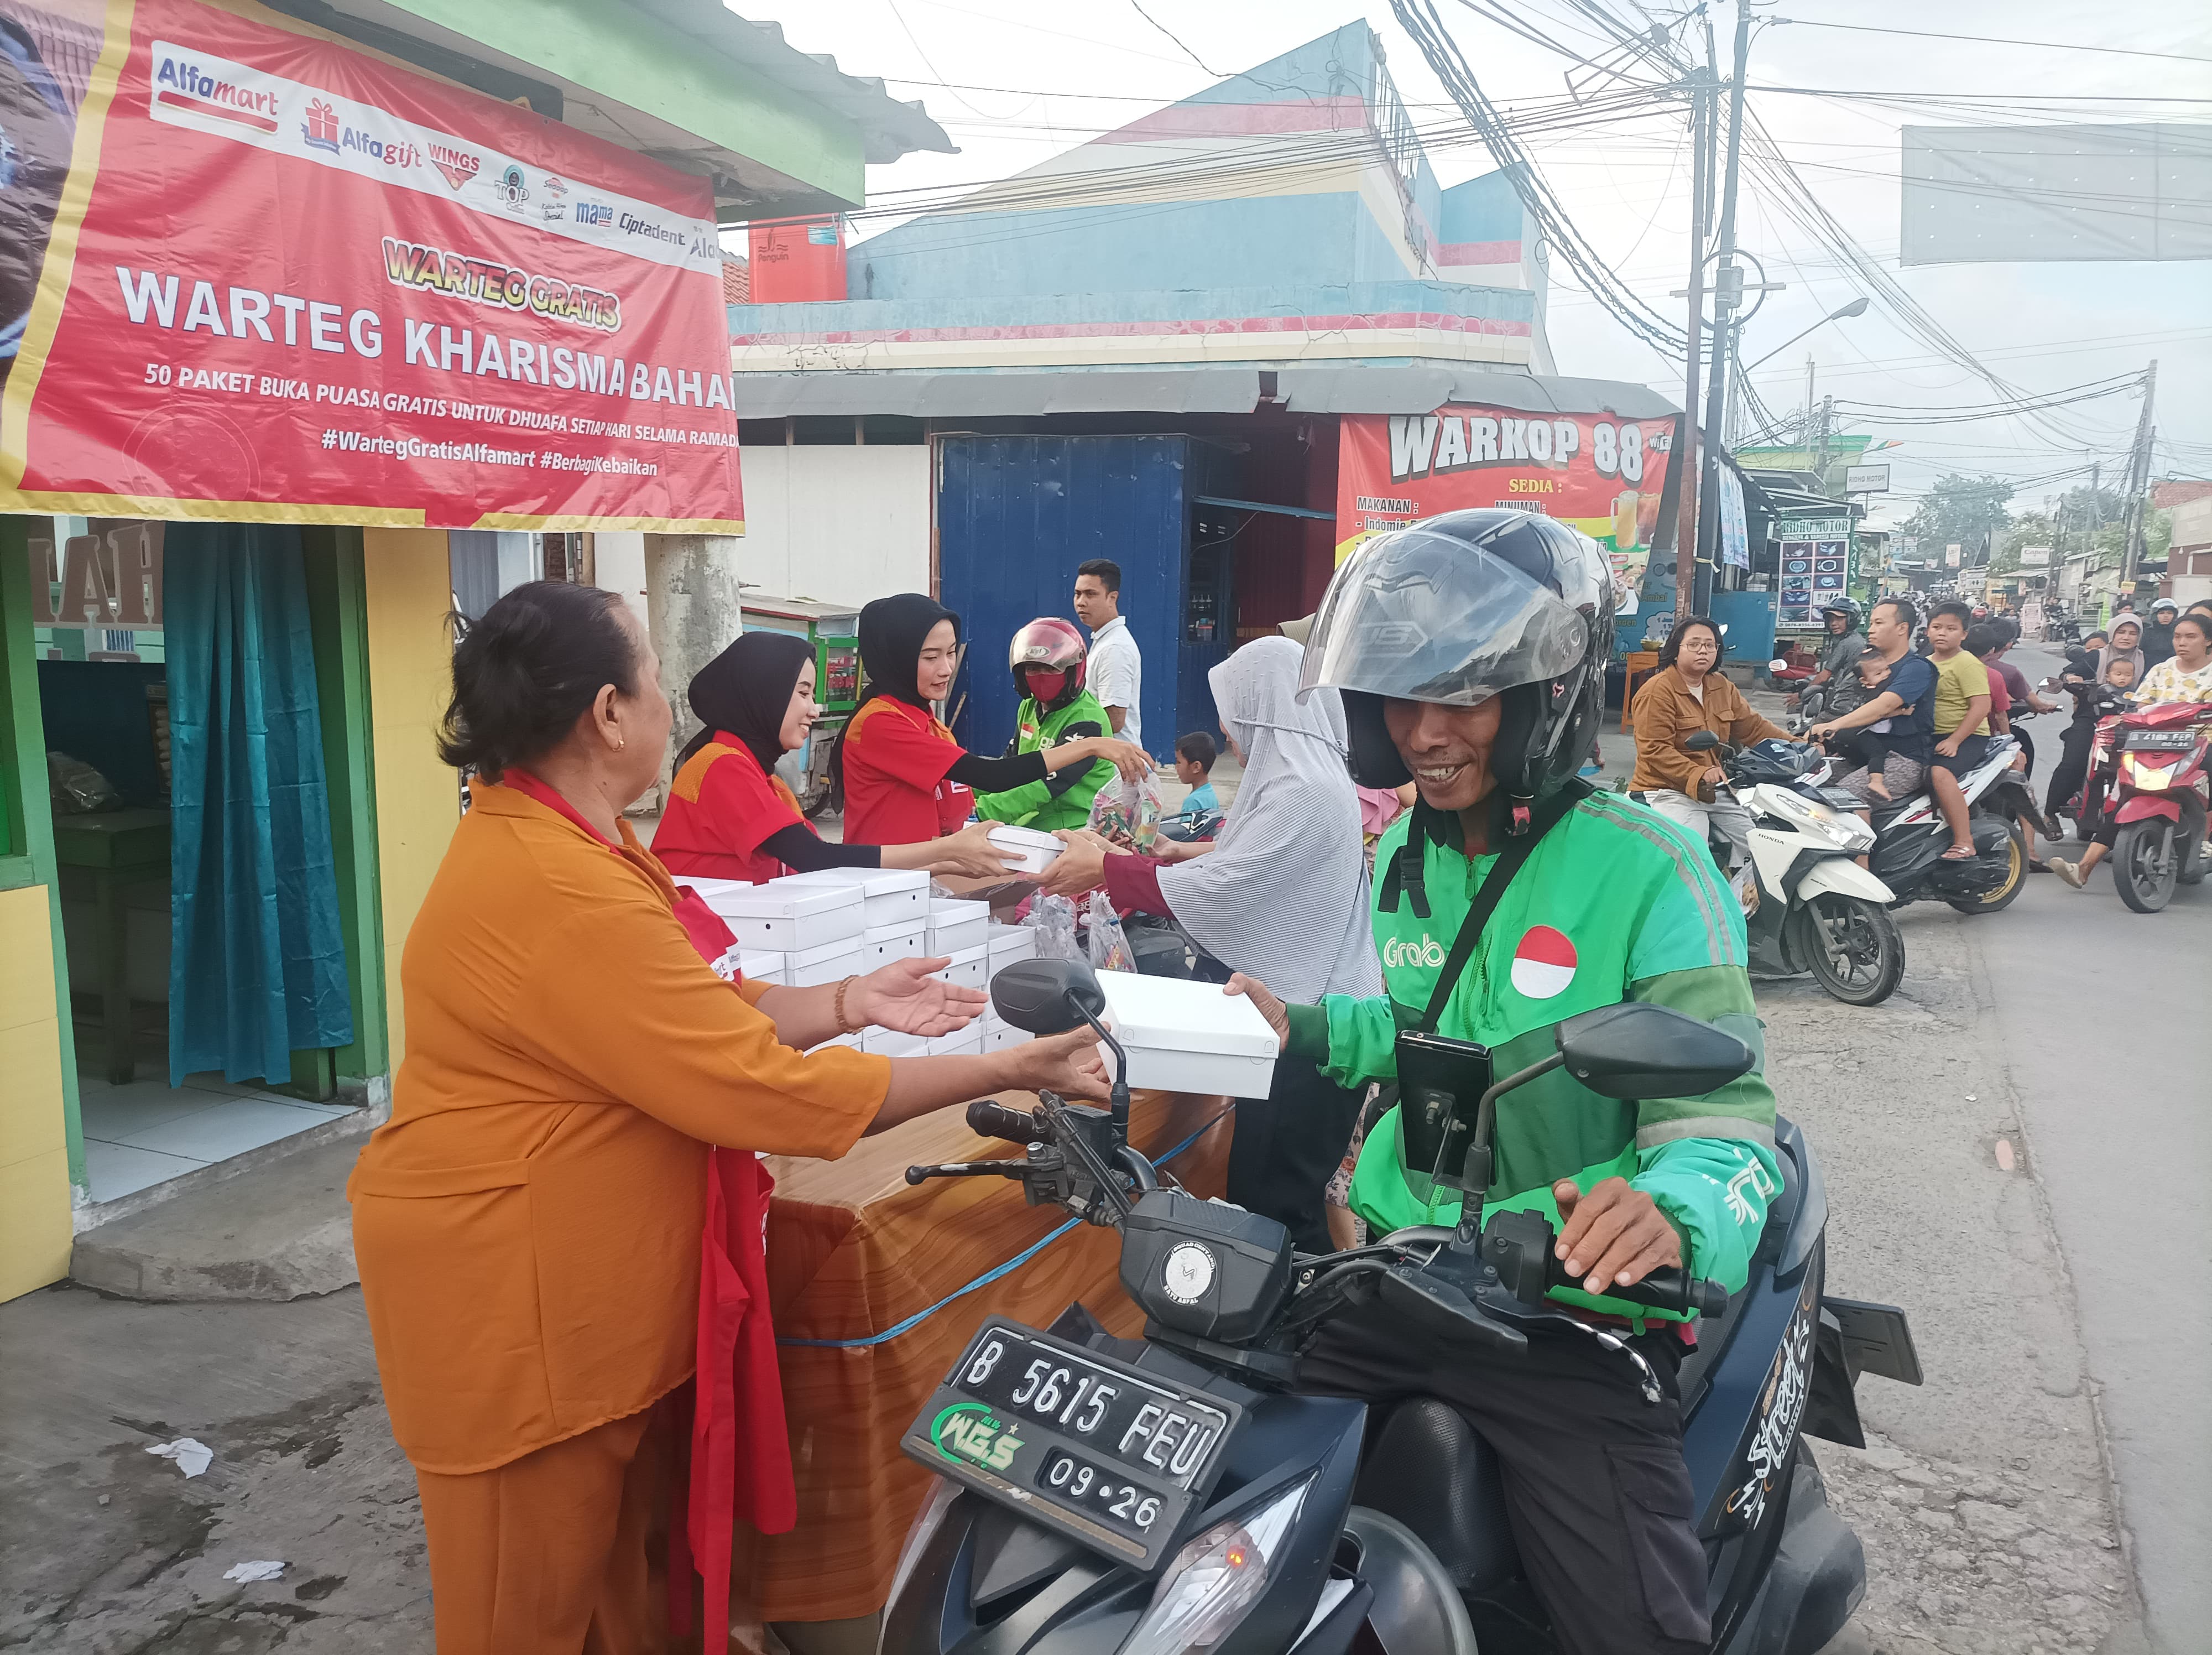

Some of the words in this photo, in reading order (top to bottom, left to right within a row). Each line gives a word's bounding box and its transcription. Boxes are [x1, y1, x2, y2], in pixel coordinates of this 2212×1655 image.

[158, 58, 278, 116] Alfamart
[342, 127, 422, 168] Alfagift
[428, 142, 479, 171] WINGS
[494, 180, 529, 205] TOP
[619, 212, 686, 245] Ciptadent
[758, 252, 789, 263] Penguin
[383, 237, 526, 310] WARTEG
[530, 275, 622, 332] GRATIS
[116, 266, 383, 358] WARTEG
[404, 318, 625, 397] KHARISMA
[144, 363, 172, 386] 50
[178, 367, 255, 394] PAKET
[259, 376, 310, 401] BUKA
[316, 386, 380, 409] PUASA
[382, 393, 447, 417] GRATIS
[451, 402, 504, 425] UNTUK
[509, 409, 567, 433] DHUAFA
[571, 417, 606, 437] SETIAP
[606, 421, 630, 439] HARI
[635, 425, 686, 444] SELAMA
[321, 429, 535, 468] #WartegGratisAlfamart
[540, 451, 658, 476] #BerbagiKebaikan
[1388, 416, 1580, 479] WARKOP
[1594, 422, 1643, 482] 88
[1357, 496, 1411, 513] MAKANAN
[1509, 478, 1554, 493] SEDIA
[1783, 521, 1812, 533] RIDHO
[1812, 520, 1848, 532] MOTOR
[1758, 833, 1785, 845] HONDA
[1383, 933, 1446, 969] Grab
[967, 1340, 1004, 1384] B
[1011, 1358, 1116, 1433] 5615
[1118, 1402, 1211, 1475] FEU
[1747, 1338, 1804, 1479] Street
